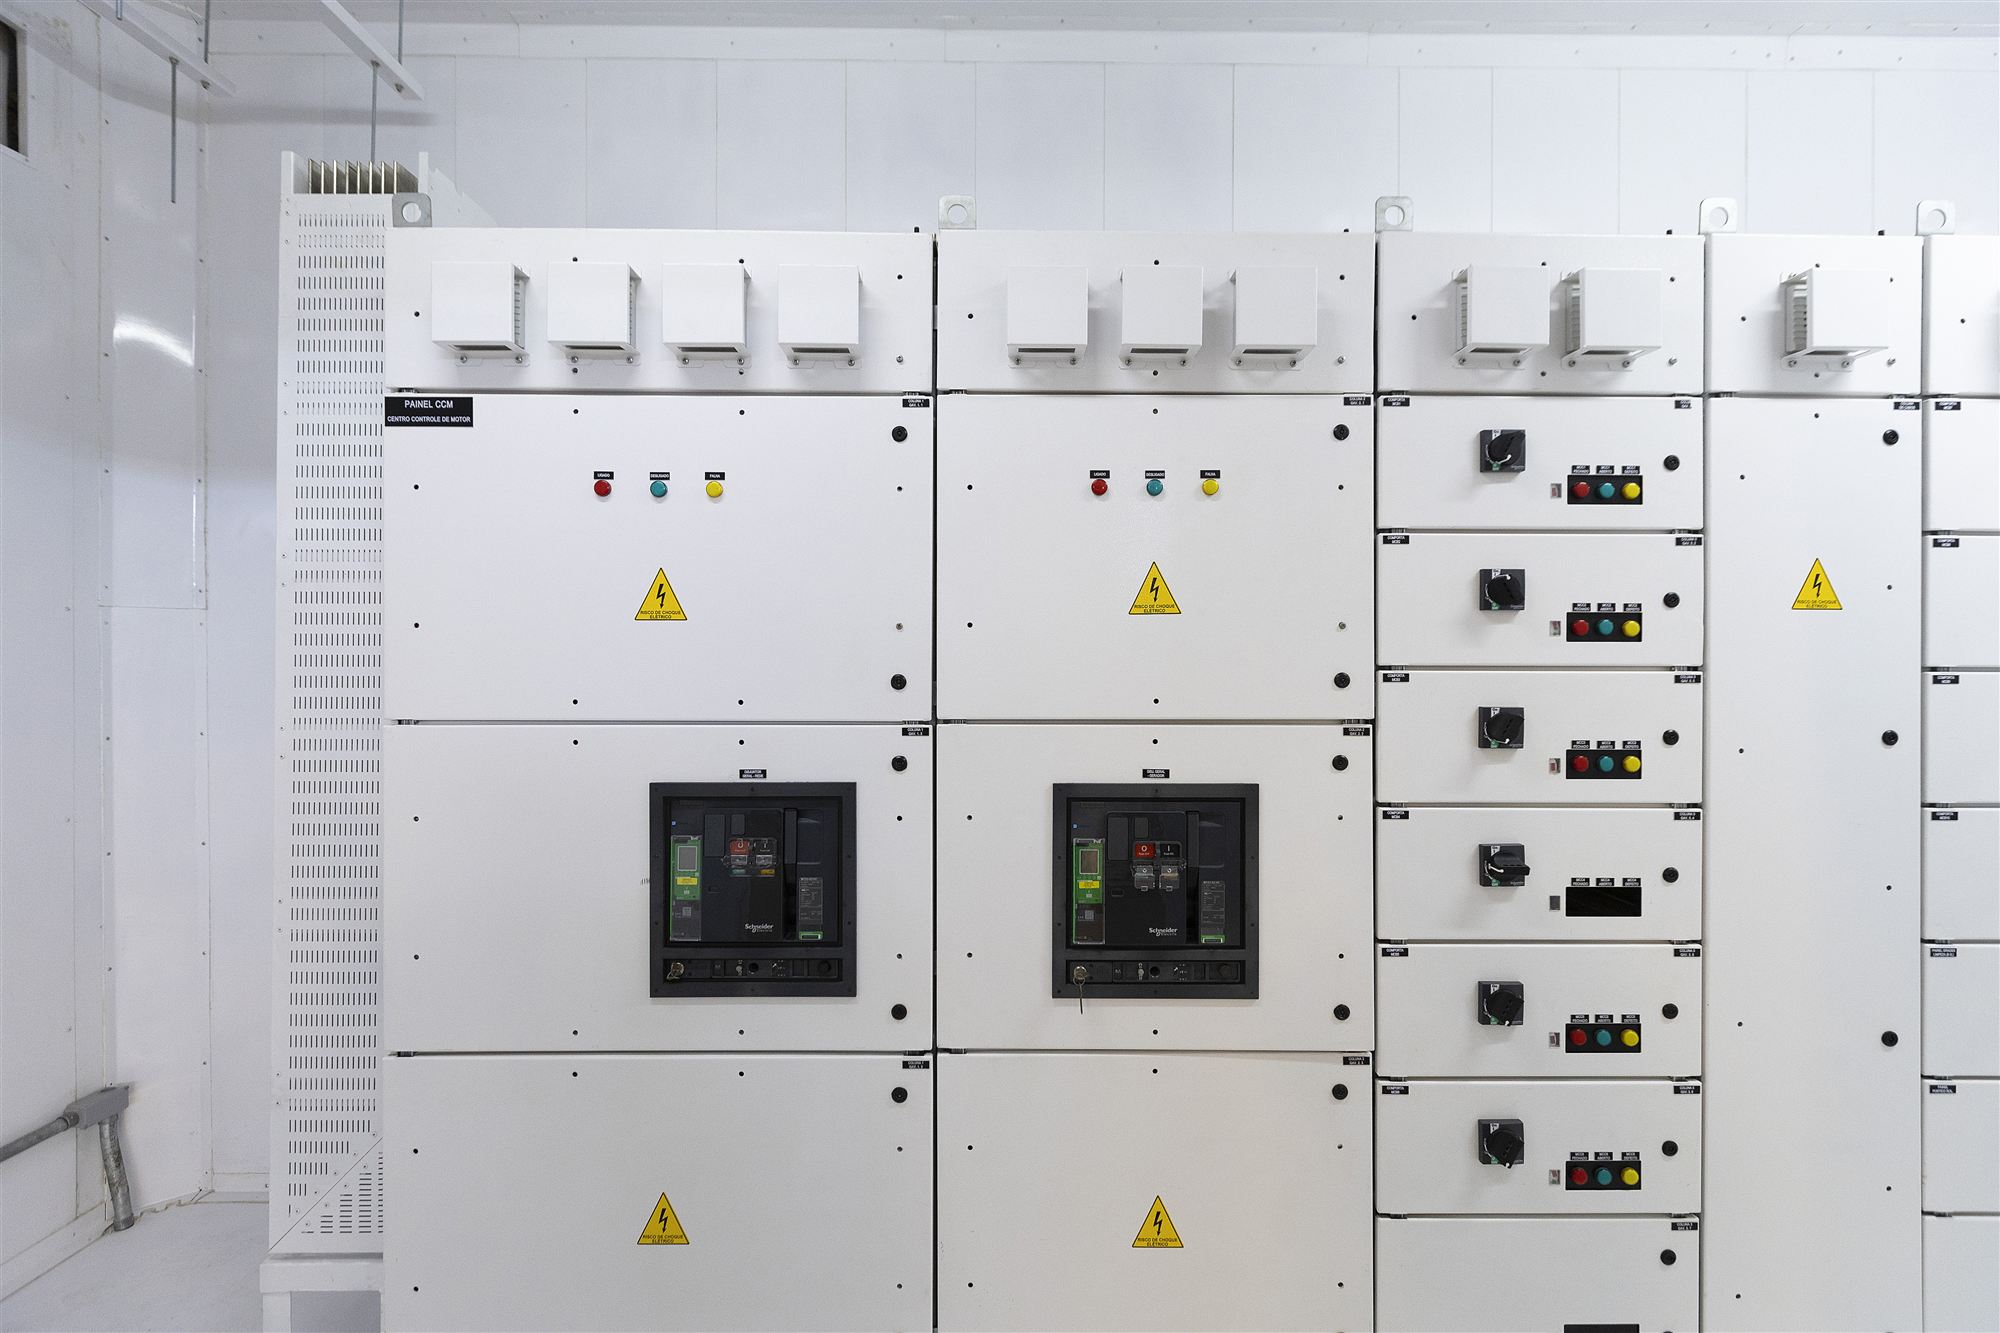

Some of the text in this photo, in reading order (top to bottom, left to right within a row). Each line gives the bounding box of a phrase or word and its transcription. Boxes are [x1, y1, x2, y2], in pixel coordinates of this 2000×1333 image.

[404, 400, 453, 409] PAINEL CCM
[744, 923, 774, 933] Schneider
[1148, 928, 1178, 936] Schneider
